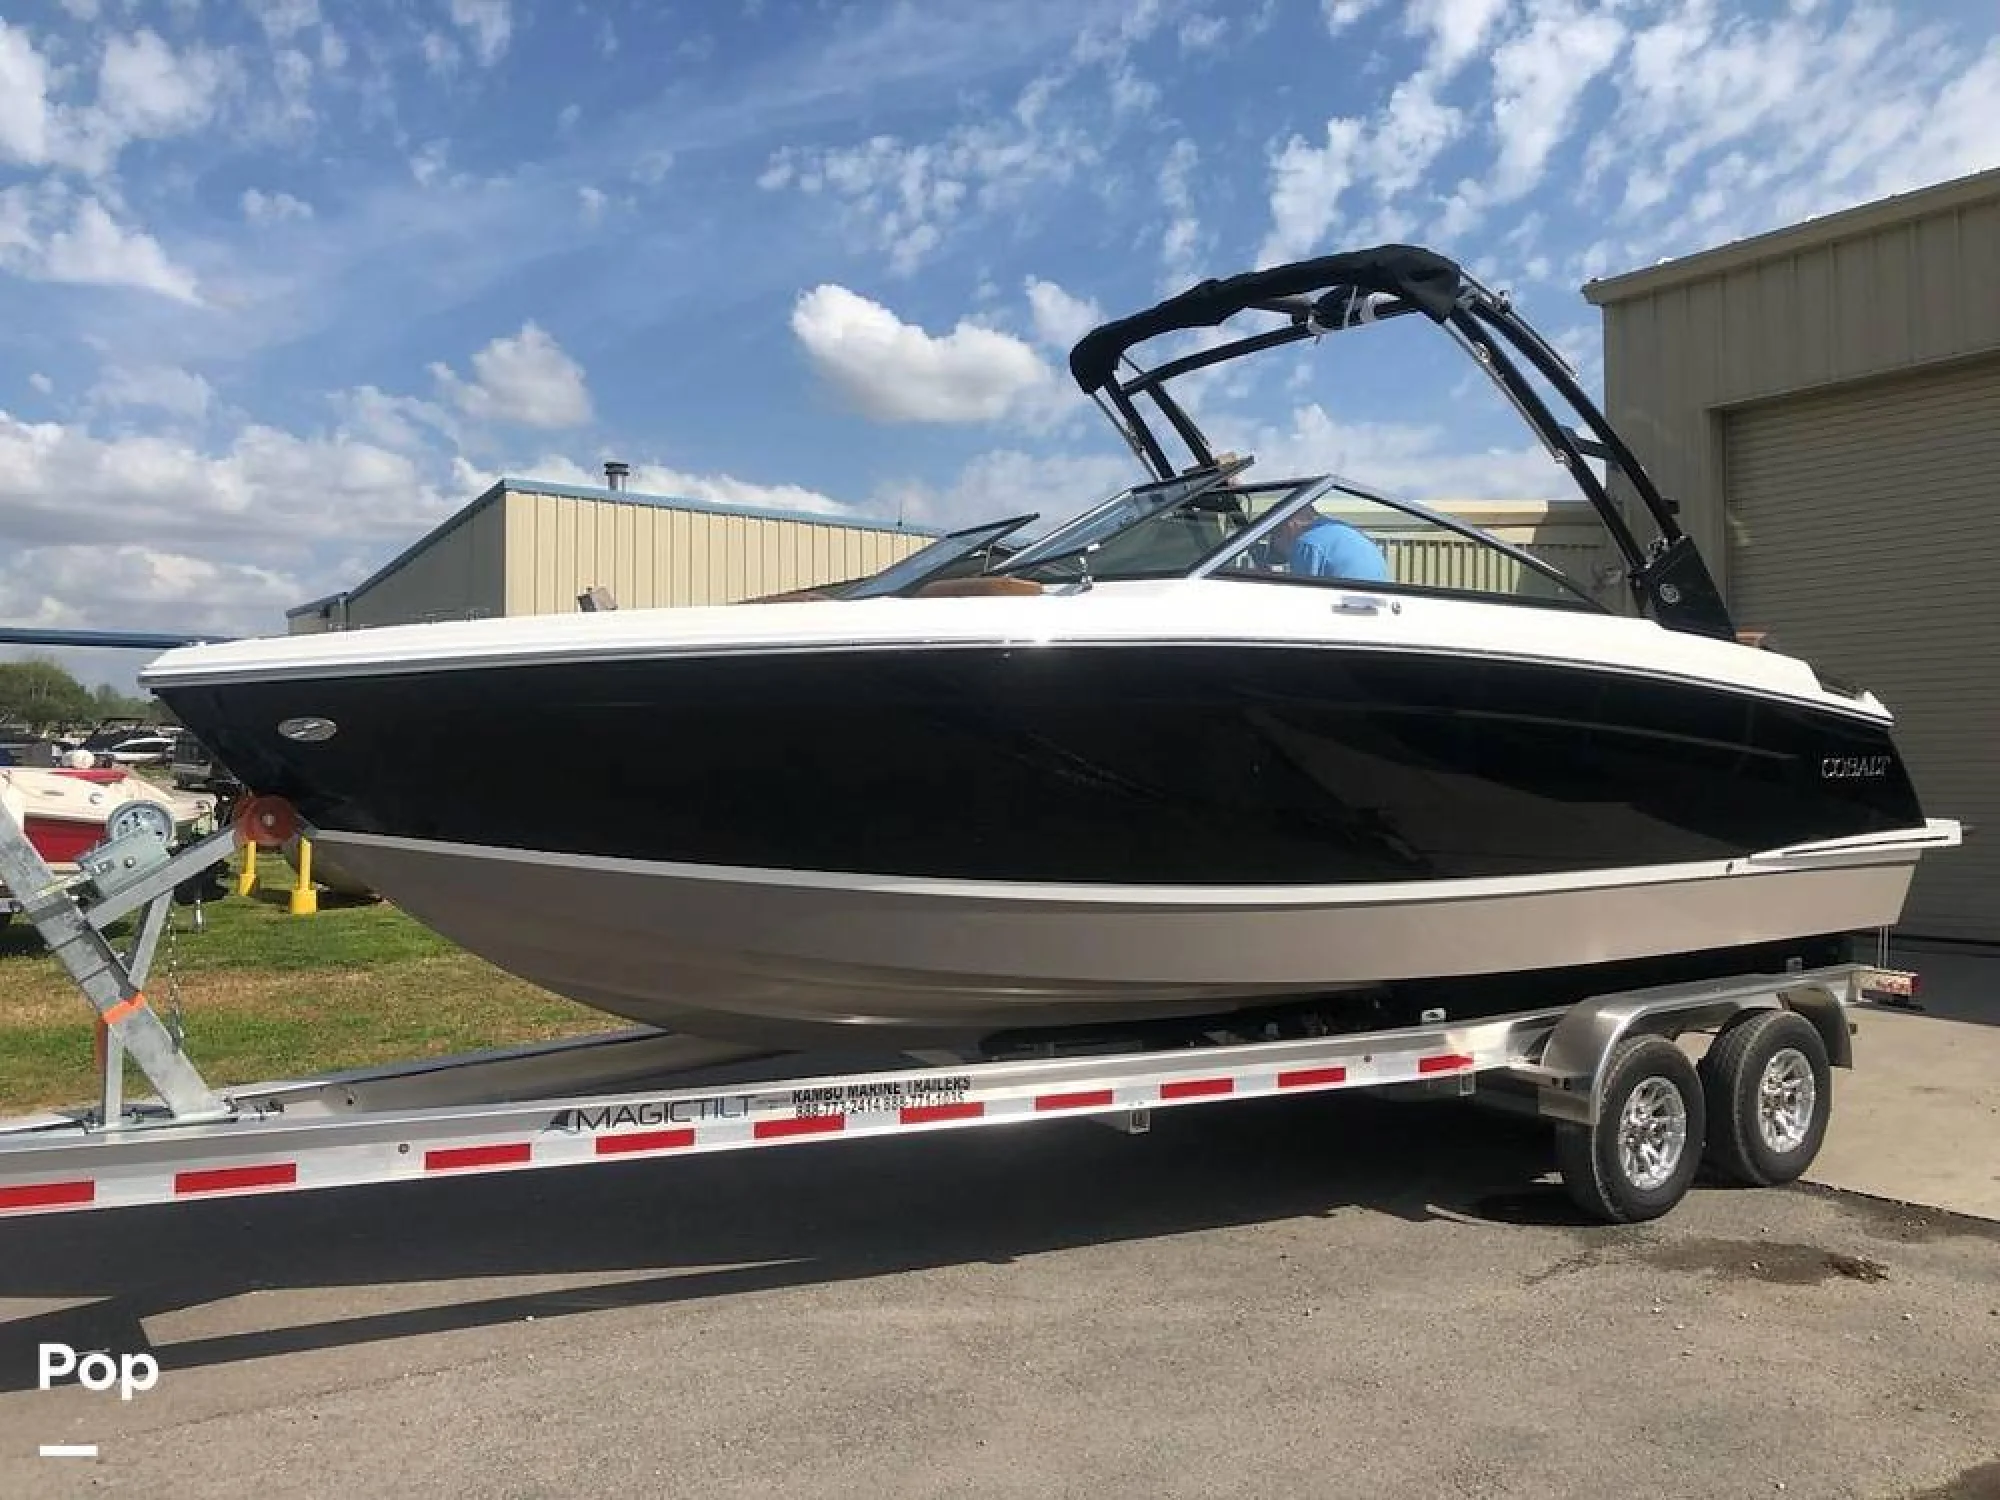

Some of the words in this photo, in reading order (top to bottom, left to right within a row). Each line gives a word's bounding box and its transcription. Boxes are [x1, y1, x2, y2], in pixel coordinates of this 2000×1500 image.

[1821, 756, 1891, 778] COBALT
[791, 1087, 843, 1104] RAMBO
[847, 1081, 901, 1099] MARINE
[905, 1075, 971, 1095] TRAILERS
[577, 1096, 757, 1131] MAGICTILT
